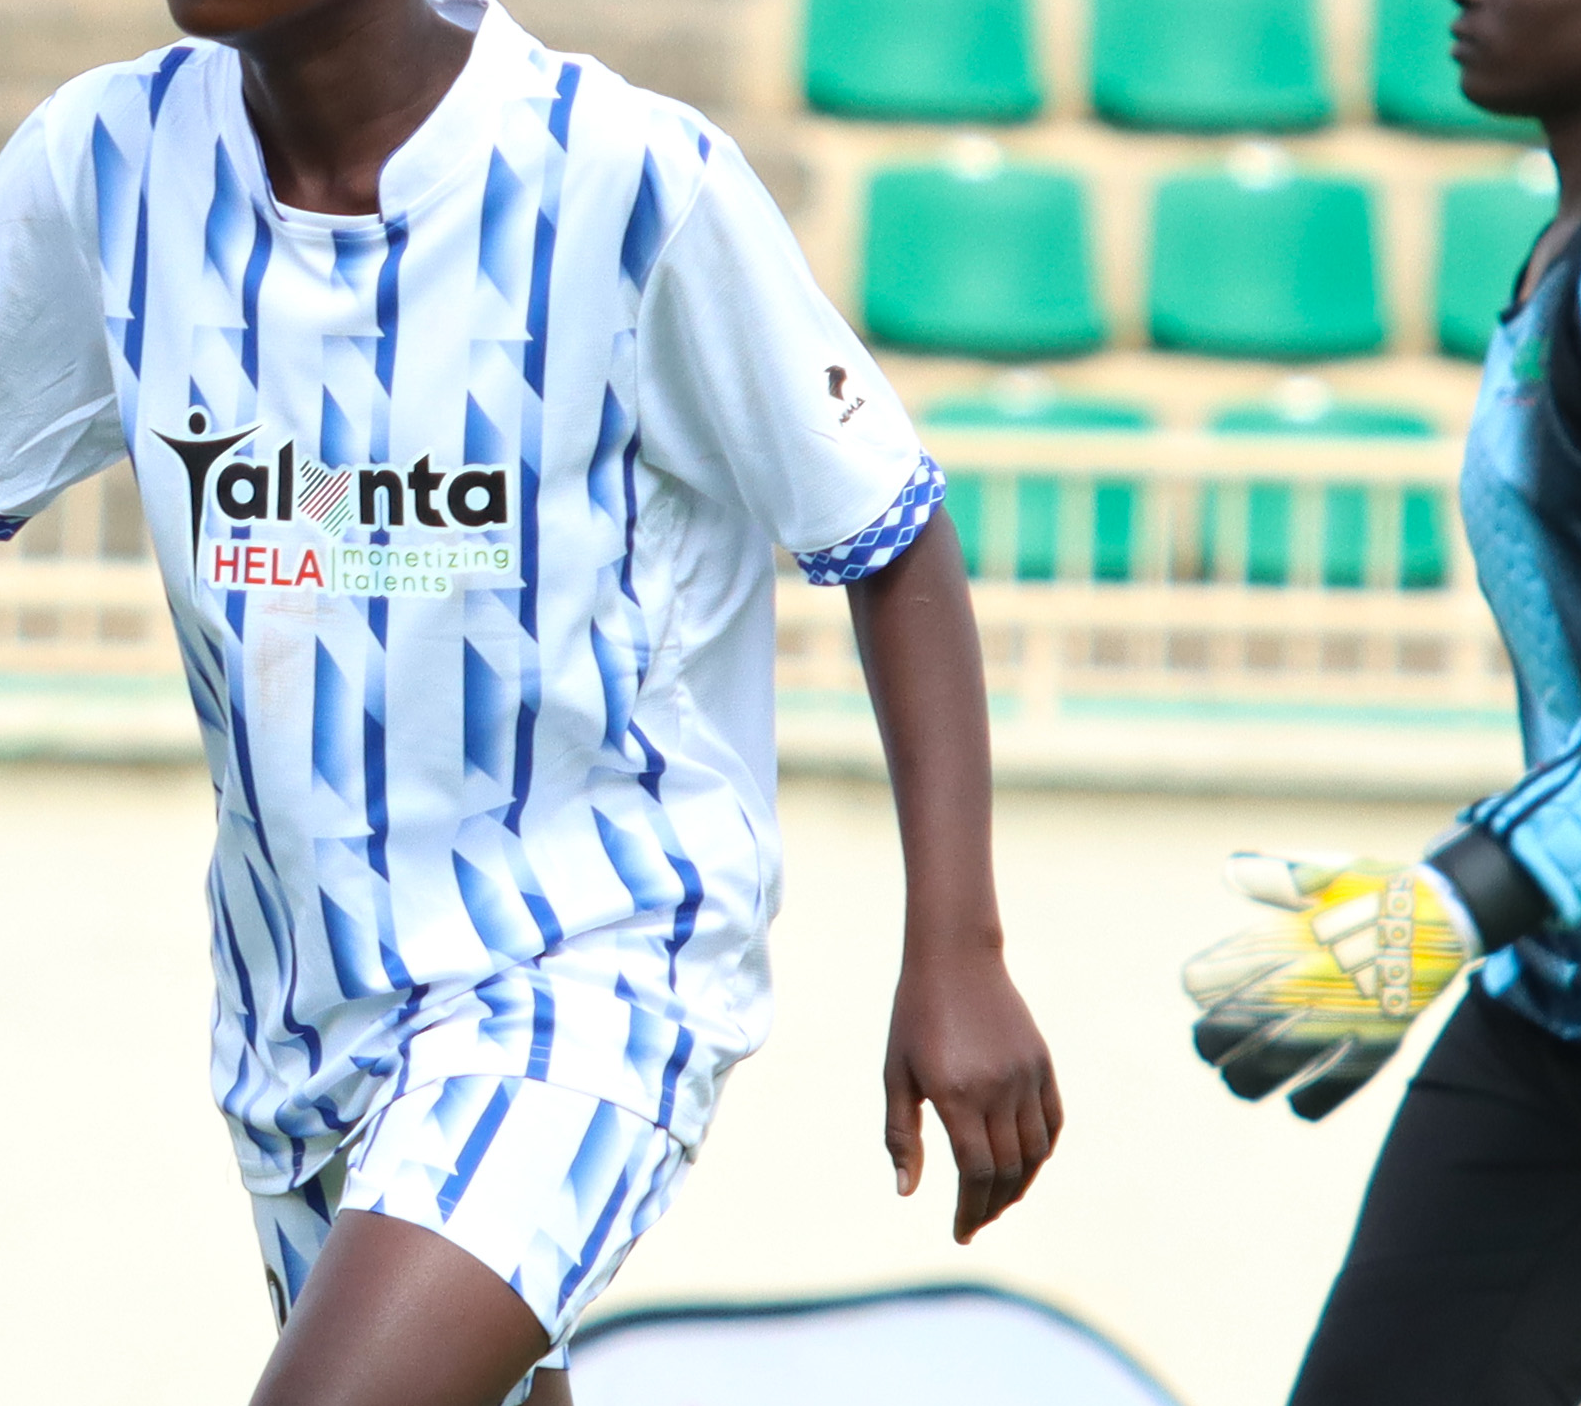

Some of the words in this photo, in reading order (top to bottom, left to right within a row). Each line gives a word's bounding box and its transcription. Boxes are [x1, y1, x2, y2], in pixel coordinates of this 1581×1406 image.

[213, 545, 325, 588] HELA
[343, 547, 510, 571] monetizing
[343, 571, 448, 593] talents
